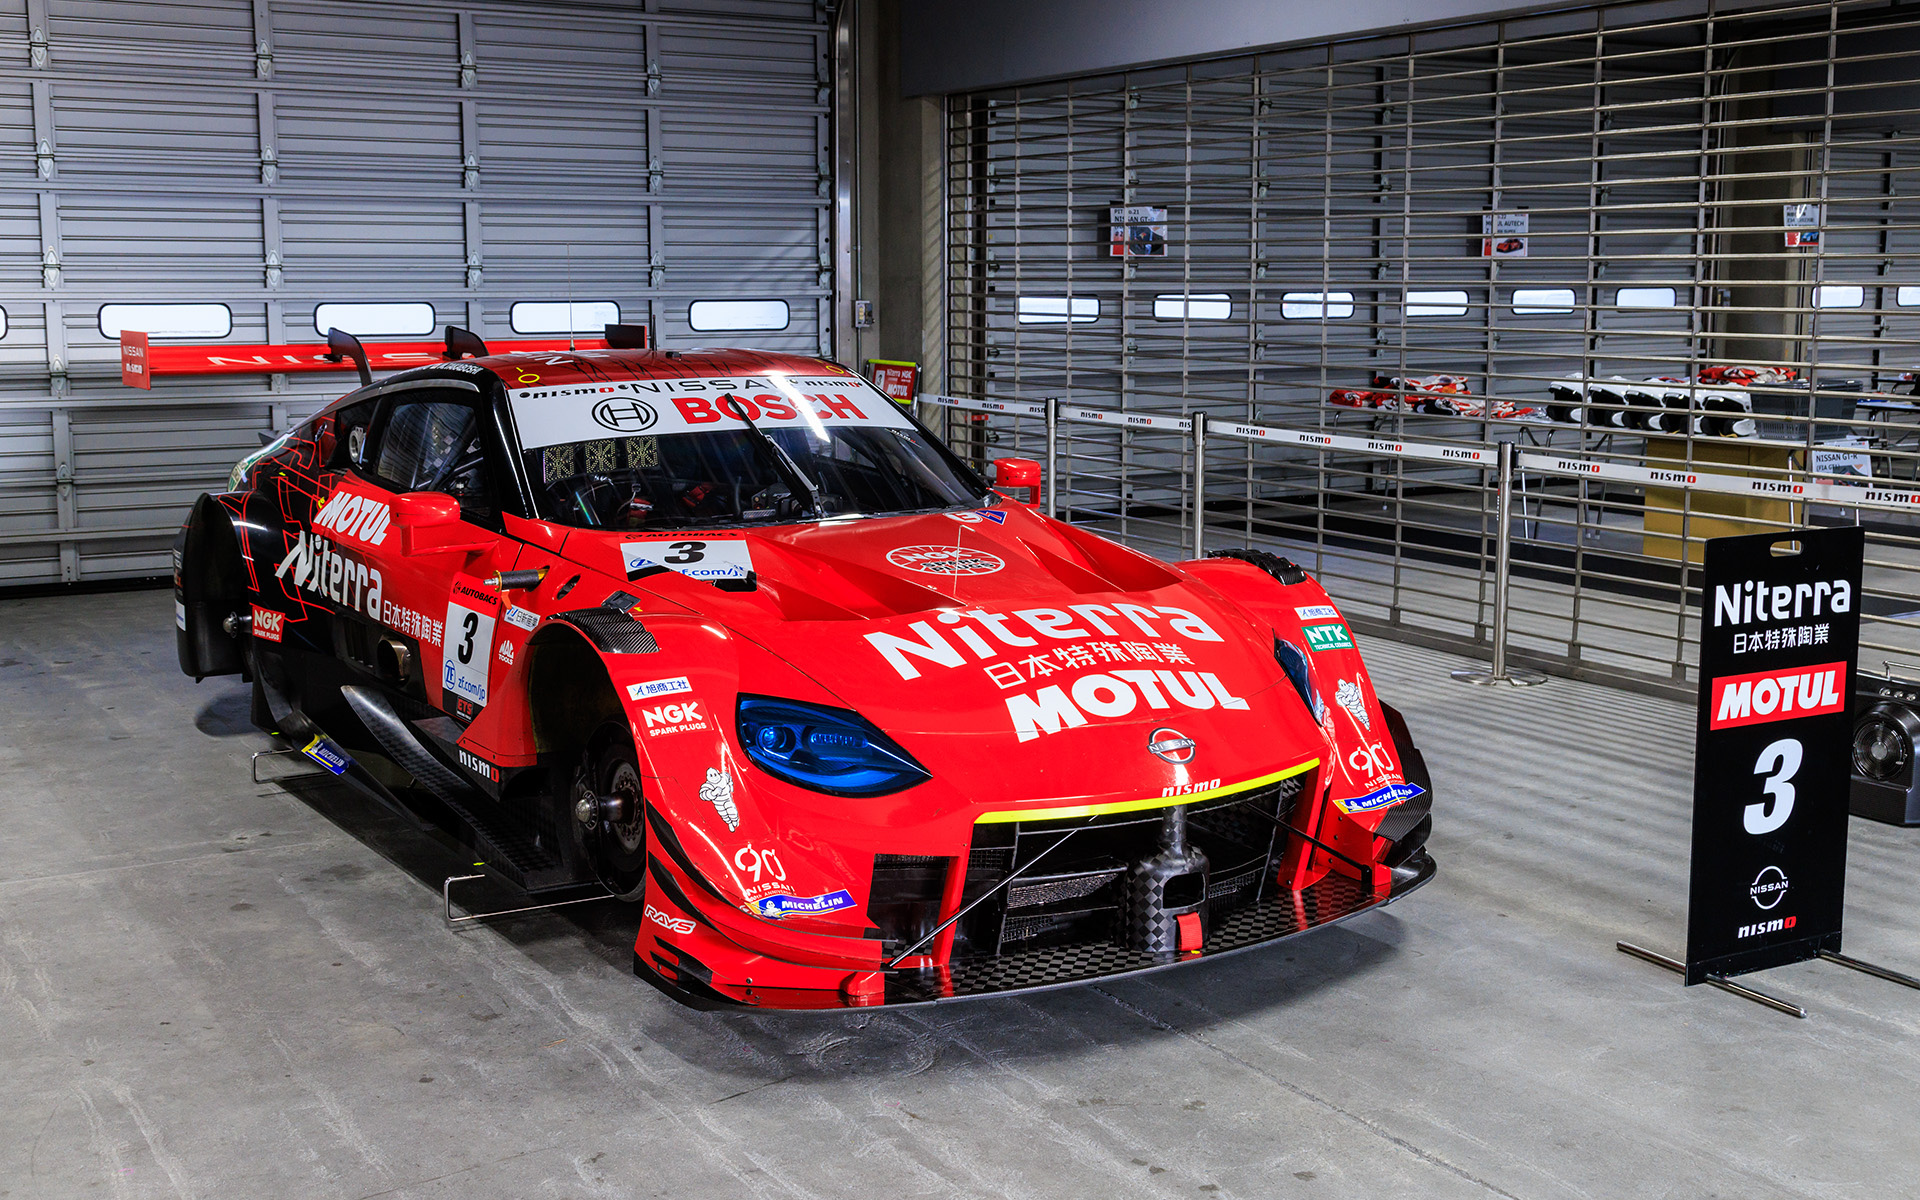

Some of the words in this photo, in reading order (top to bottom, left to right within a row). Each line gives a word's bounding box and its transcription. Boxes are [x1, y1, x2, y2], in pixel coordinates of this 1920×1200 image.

[123, 345, 144, 358] NISSAN
[876, 374, 883, 386] 3
[901, 370, 912, 379] NGK
[533, 388, 614, 399] nismo
[886, 384, 908, 397] MOTUL
[671, 394, 869, 424] BOSCH
[937, 397, 959, 405] nismo
[982, 402, 1005, 410] nismo
[1080, 411, 1103, 420] nismo
[1128, 416, 1152, 425] nismo
[1236, 427, 1265, 436] nismo
[1299, 434, 1331, 444] nismo
[1368, 442, 1402, 452] nismo
[1443, 449, 1480, 460] nismo
[1558, 460, 1600, 473] nismo
[1816, 453, 1840, 463] NISSAN
[1650, 471, 1696, 484] nismo
[1752, 481, 1803, 495] nismo
[1865, 491, 1920, 504] nismo
[313, 491, 391, 546] MOTUL
[664, 541, 706, 564] 3
[899, 550, 972, 562] NGK
[275, 530, 383, 621] Niterra
[461, 586, 498, 605] AUTOBACS
[1714, 579, 1851, 628] Niterra
[254, 606, 283, 632] NGK
[383, 599, 444, 648] 日本特殊陶業
[266, 631, 280, 641] PLUGS
[458, 612, 479, 665] 3
[863, 603, 1225, 681] Niterra
[1305, 625, 1348, 643] NTK
[1733, 622, 1830, 655] 日本特殊陶業
[498, 653, 513, 665] TOOLS
[983, 641, 1195, 690] 日本特殊陶業
[458, 676, 486, 701] zf.com/jp
[646, 679, 689, 694] 旭商工社
[1717, 670, 1839, 721] MOTUL
[457, 698, 473, 716] ETS
[642, 701, 703, 728] NGK
[1005, 670, 1250, 743] MOTUL
[649, 727, 679, 737] SPARK
[679, 722, 707, 732] PLUGS
[318, 747, 345, 767] MICHELIN
[1349, 742, 1394, 778] 90
[459, 750, 500, 783] nismo
[1162, 778, 1220, 798] nismo
[1365, 774, 1402, 789] NISSAN
[1743, 738, 1804, 835] 3
[1361, 789, 1413, 808] MICHELIN
[734, 843, 786, 882] 90
[745, 881, 795, 897] NISSAN
[1750, 880, 1789, 896] NISSAN
[781, 896, 844, 911] MICHELIN
[644, 904, 697, 935] RAYS
[1738, 915, 1797, 939] nismo
